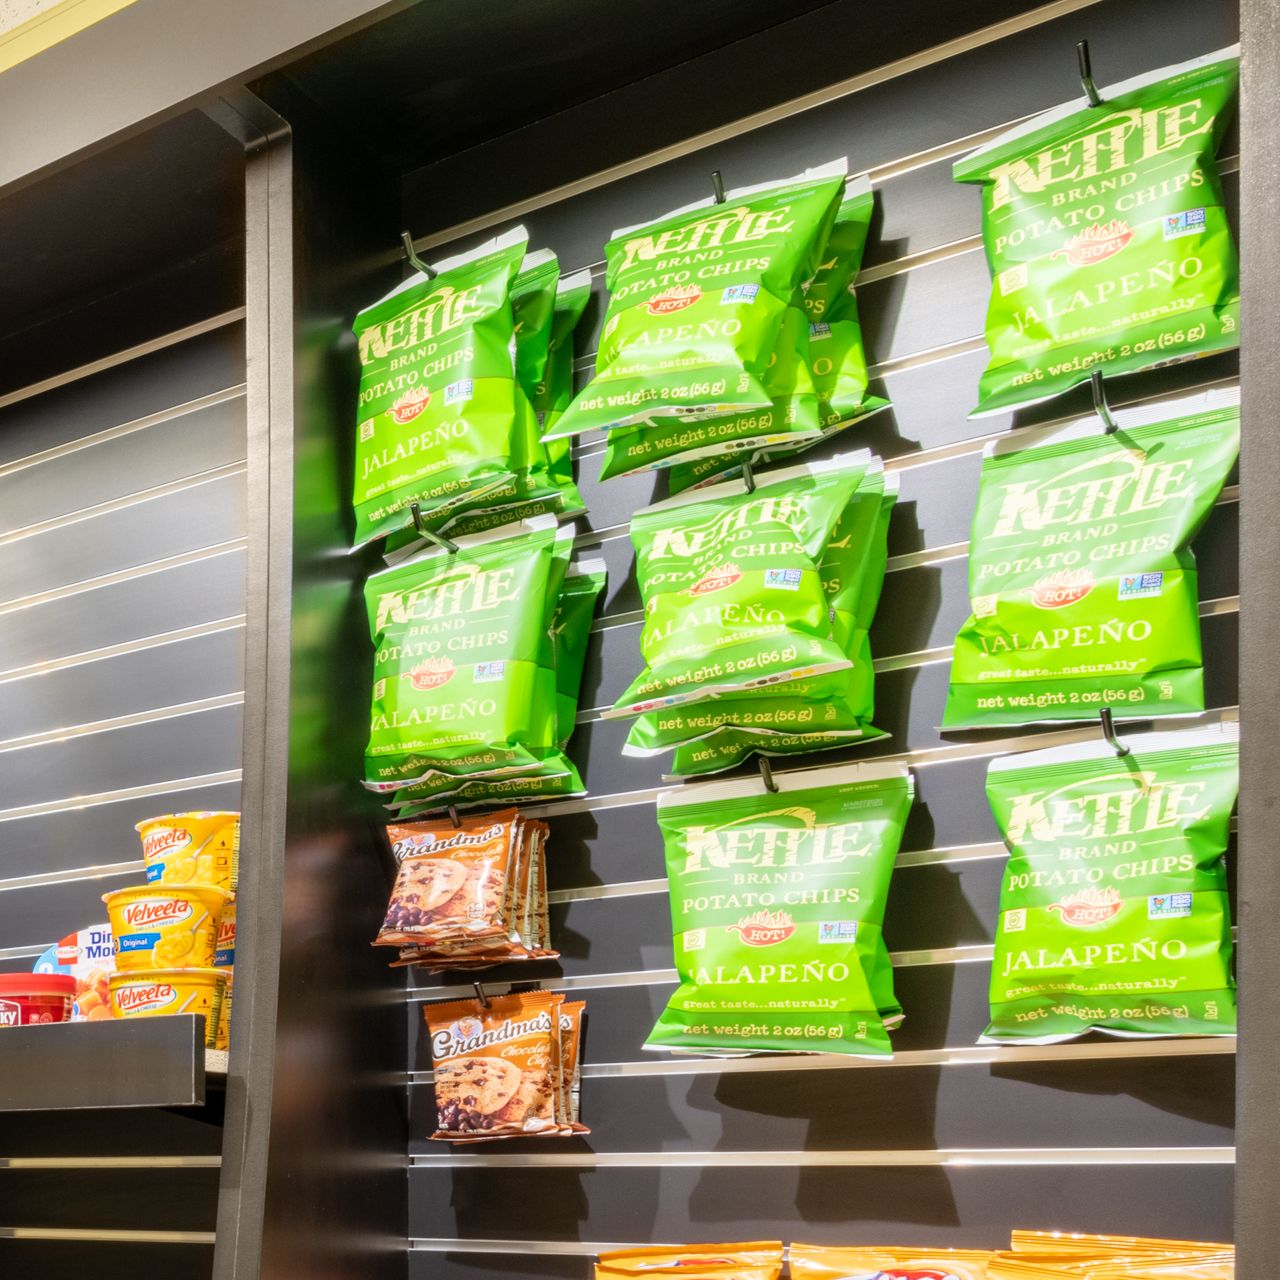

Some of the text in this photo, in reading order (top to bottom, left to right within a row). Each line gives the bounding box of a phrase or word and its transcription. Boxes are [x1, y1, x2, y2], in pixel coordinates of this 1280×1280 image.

[989, 98, 1215, 215] KETTLE
[1052, 171, 1137, 207] BRAND
[996, 169, 1204, 254] POTATO CHIPS
[620, 206, 792, 271] KETTLE
[1080, 238, 1122, 259] HOT!
[656, 250, 723, 271] BRAND
[609, 256, 771, 307] POTATO CHIPS
[658, 298, 691, 311] HOT!
[1014, 257, 1202, 336] JALAPEÑO
[391, 343, 438, 372] BRAND
[359, 347, 474, 406] POTATO CHIPS
[401, 403, 424, 420] HOT!
[363, 420, 469, 479] JALAPEÑO
[983, 448, 1197, 540] KETTLE
[1041, 523, 1119, 547] BRAND
[731, 542, 805, 558] CHIPS
[978, 534, 1170, 579] POTATO CHIPS
[699, 577, 732, 592] HOT!
[1044, 587, 1083, 601] HOT!
[410, 619, 465, 637] BRAND
[980, 618, 1152, 657] JALAPEÑO
[376, 630, 508, 665] POTATO CHIPS
[419, 672, 448, 685] HOT!
[1002, 771, 1212, 845] KETTLE
[392, 823, 504, 861] Grandma's
[679, 806, 870, 876] KETTLE
[1059, 841, 1137, 860] BRAND
[734, 872, 804, 884] BRAND
[1009, 854, 1194, 891] POTATO CHIPS
[127, 900, 189, 924] Velveeta
[682, 888, 860, 913] POTATO CHIPS
[1072, 906, 1113, 920] HOT!
[124, 938, 147, 947] Original
[750, 929, 786, 941] HOT!
[1003, 939, 1187, 976] JALAPEÑO
[117, 984, 171, 1008] Velveeta
[432, 1013, 552, 1061] Grandma's
